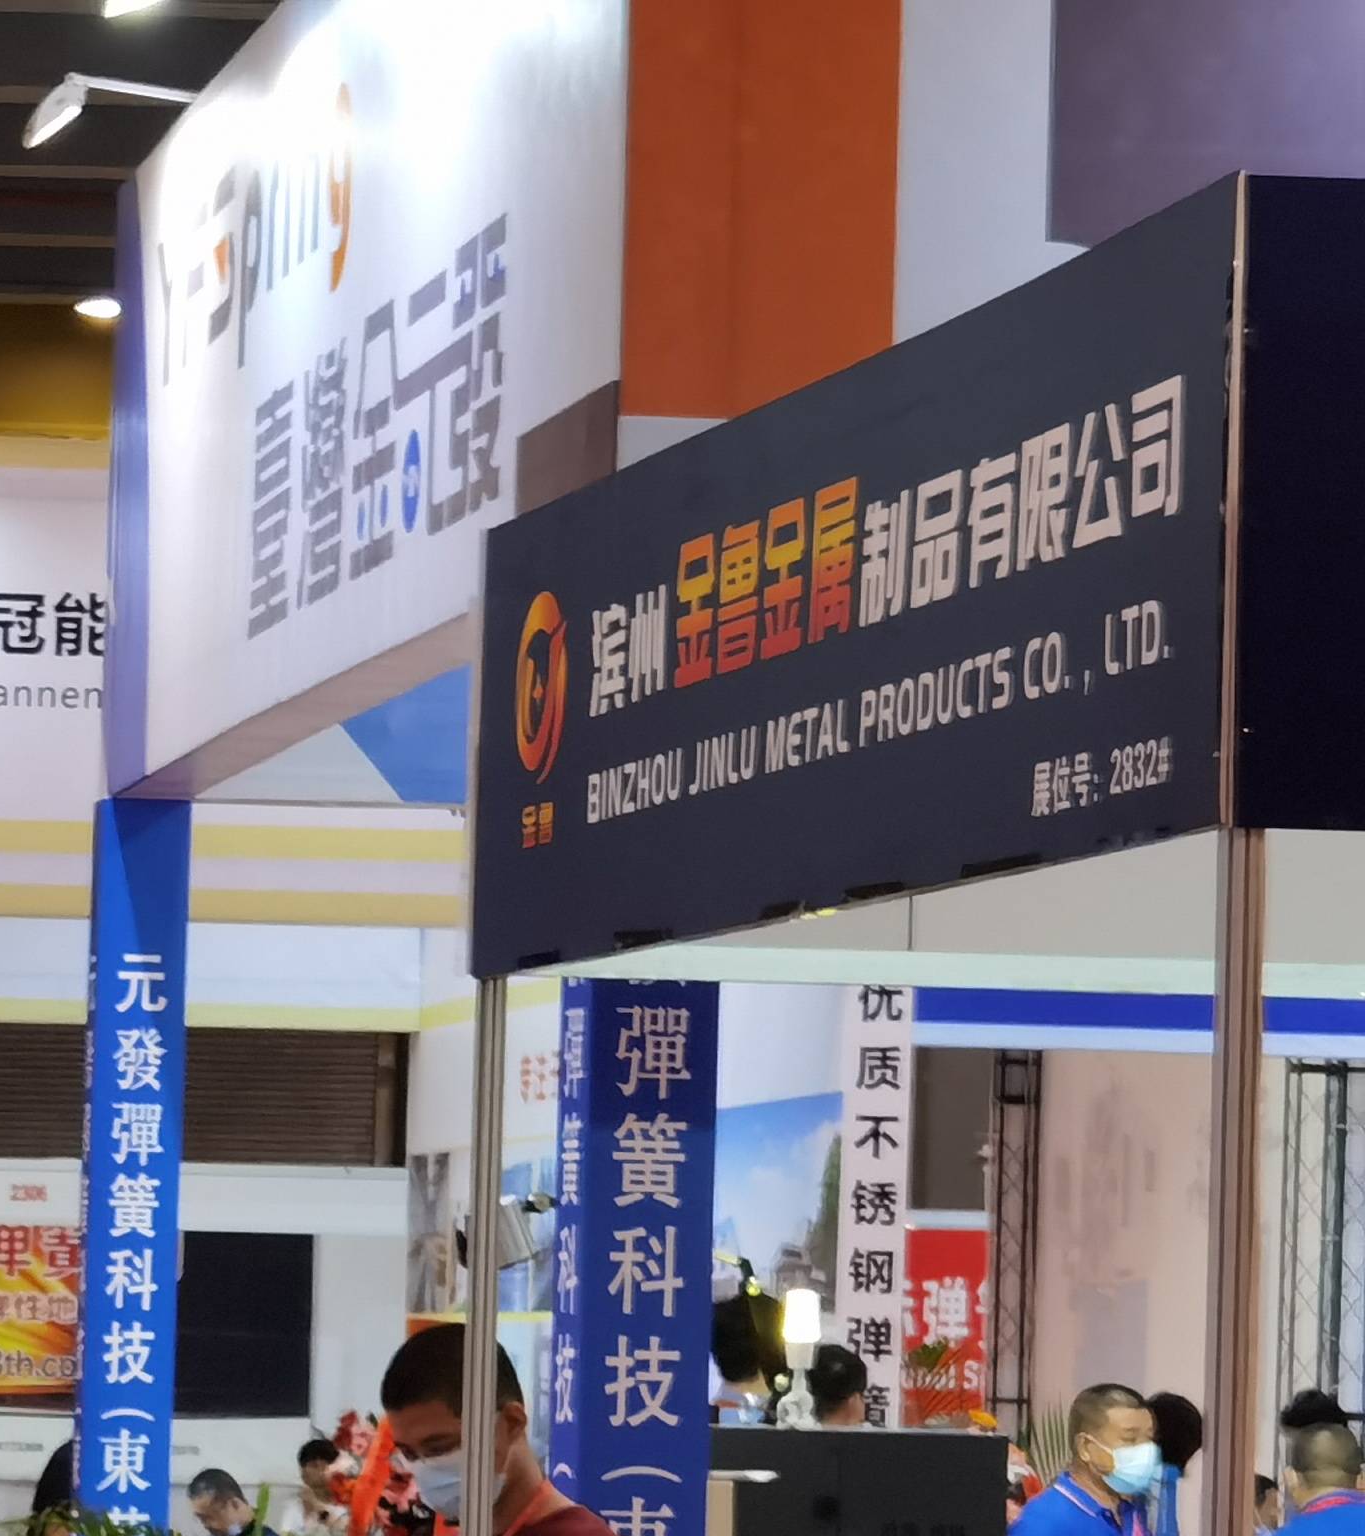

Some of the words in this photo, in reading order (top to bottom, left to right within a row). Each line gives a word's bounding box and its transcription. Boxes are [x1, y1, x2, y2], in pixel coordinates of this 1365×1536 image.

[587, 747, 684, 824] BINZHOU
[688, 724, 759, 797] JINLU
[764, 699, 850, 774] METAL
[858, 646, 1013, 749] PRODUCTS
[1105, 599, 1171, 676] LTD.
